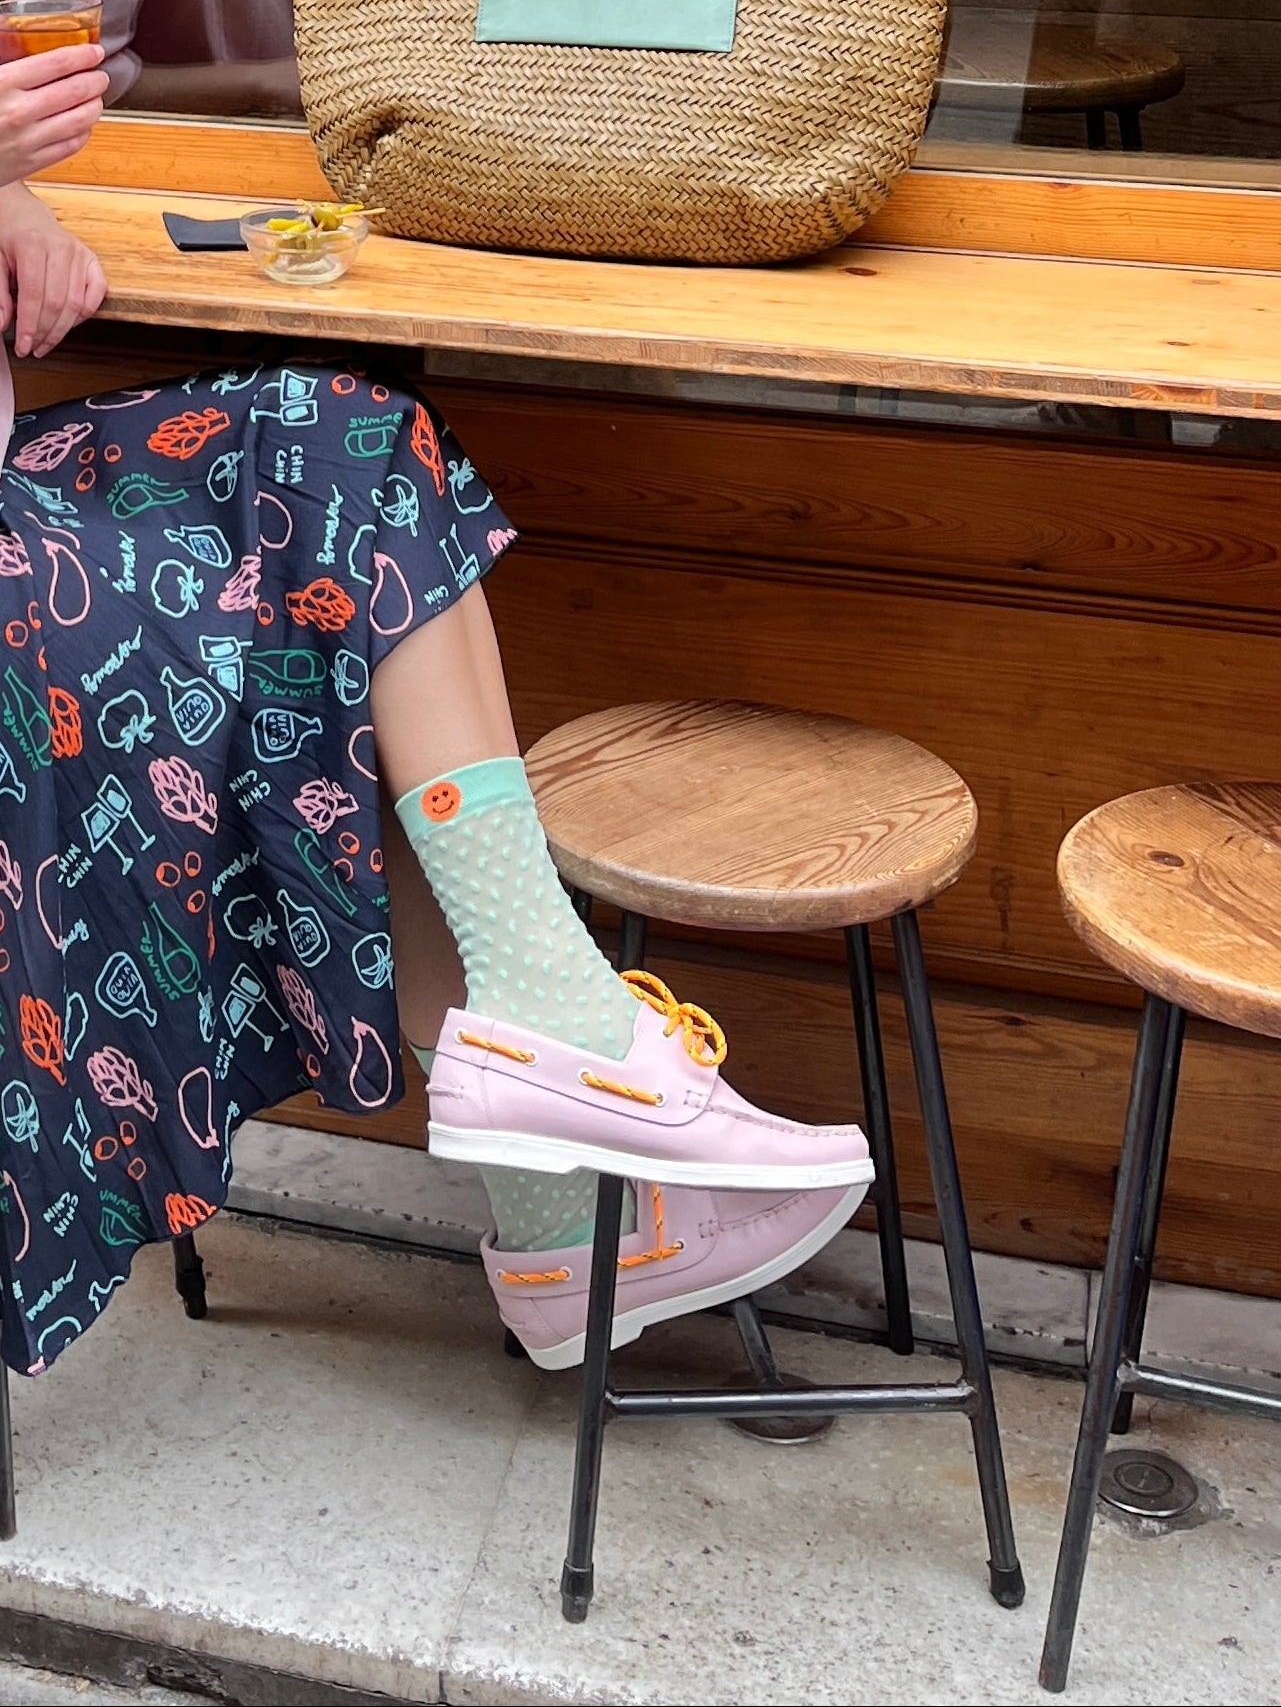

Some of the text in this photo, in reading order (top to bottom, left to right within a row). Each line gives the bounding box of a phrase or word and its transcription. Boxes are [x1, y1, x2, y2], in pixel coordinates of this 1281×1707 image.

[348, 412, 403, 428] SUMME
[290, 444, 305, 484] CHIN
[237, 781, 271, 812] CHIN
